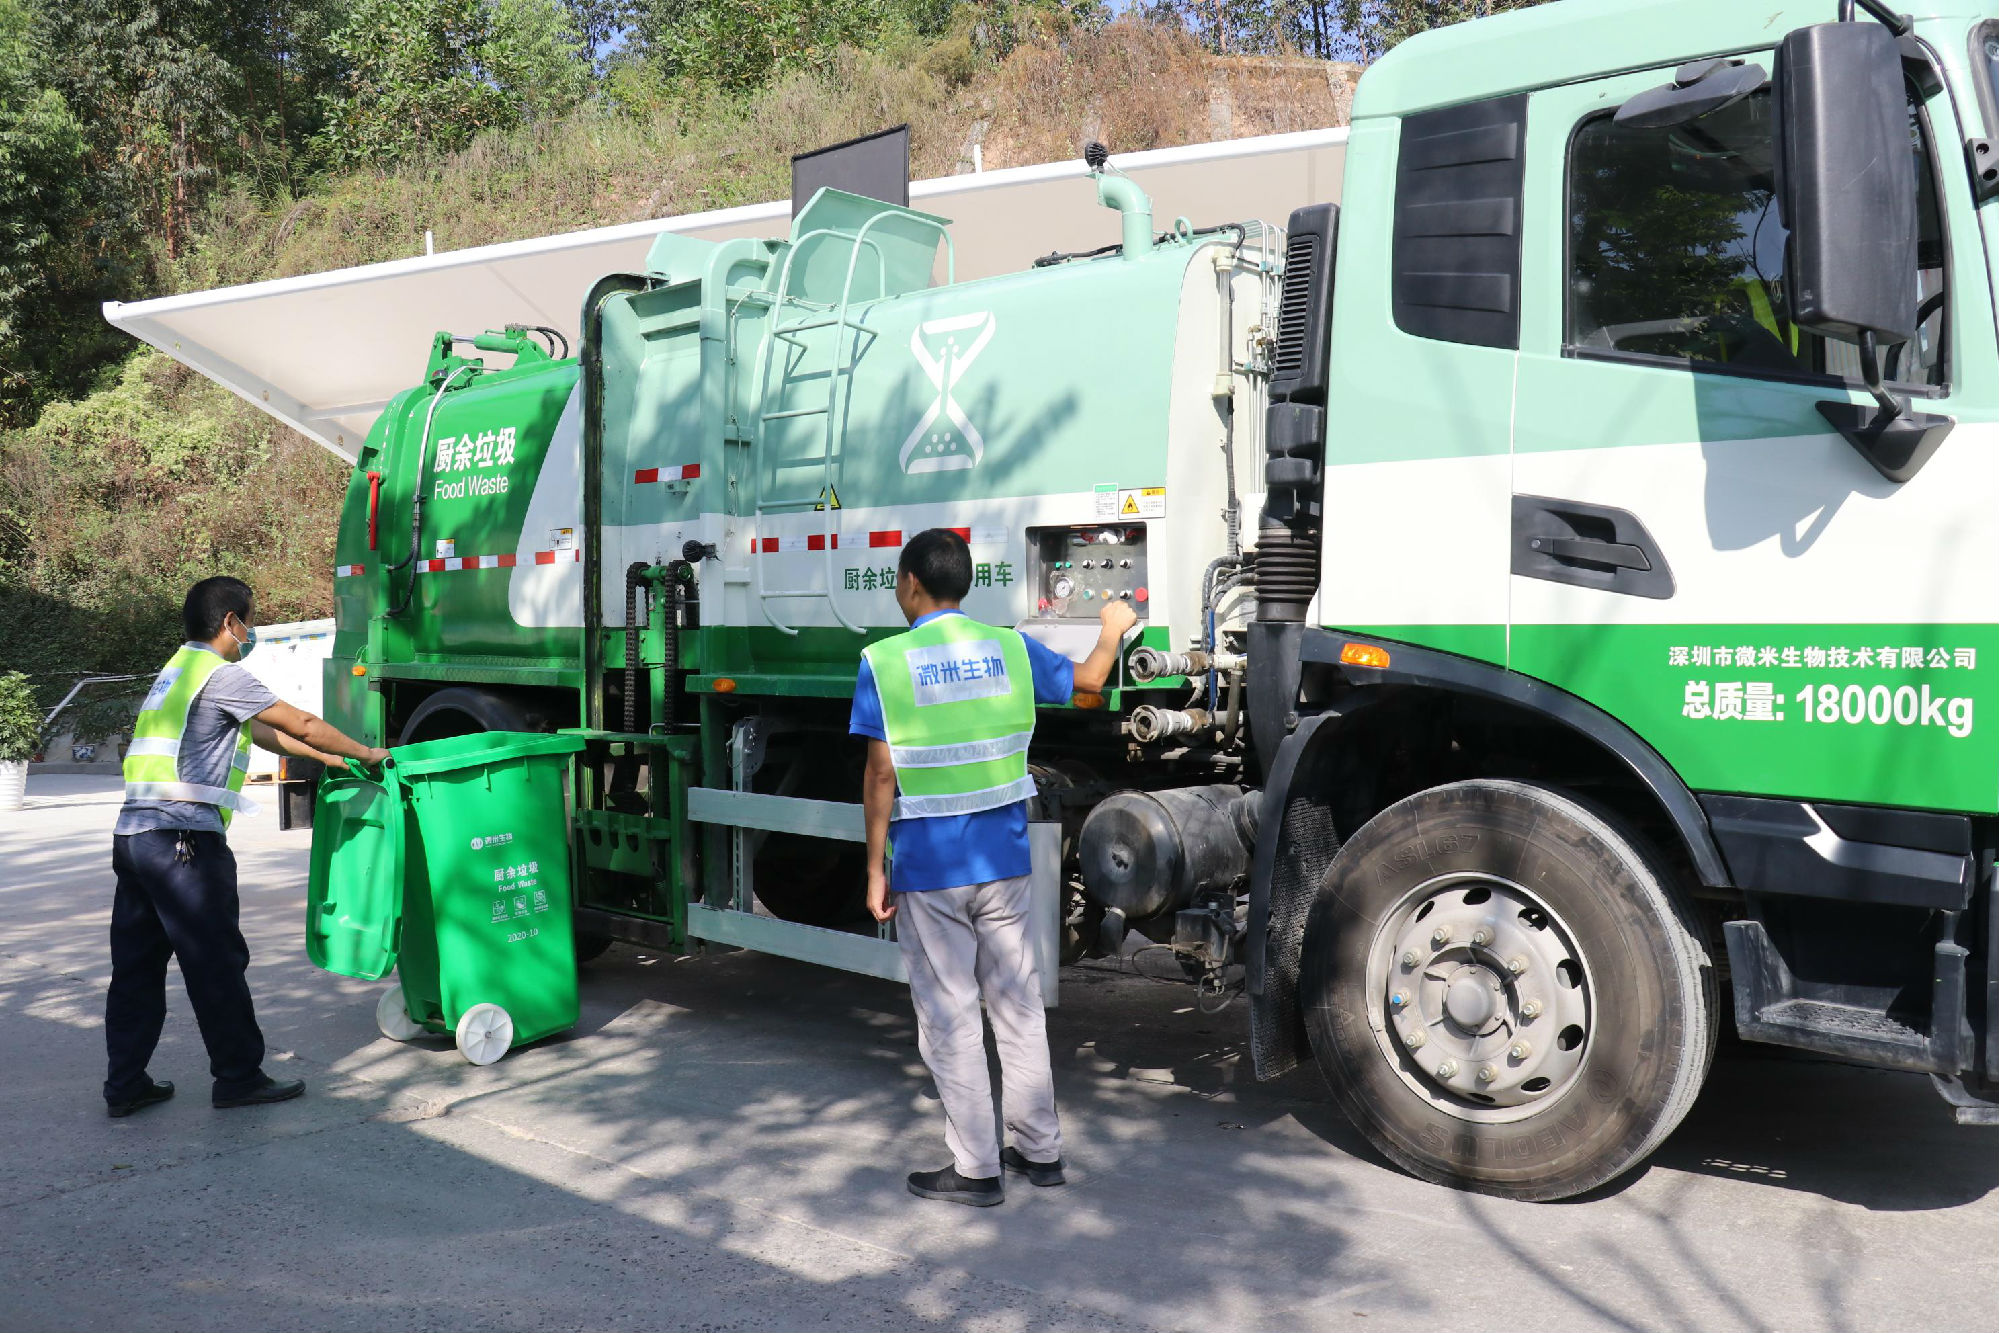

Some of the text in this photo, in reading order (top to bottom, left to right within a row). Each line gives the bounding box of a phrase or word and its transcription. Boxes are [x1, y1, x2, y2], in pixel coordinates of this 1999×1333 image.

[434, 427, 516, 473] 厨余垃圾
[434, 473, 509, 500] Food Waste
[1668, 645, 1977, 670] 深圳市微米生物技术有限公司
[915, 656, 1005, 687] 微米生物
[1796, 684, 1974, 738] 18000kg
[494, 861, 539, 882] 厨余垃圾
[498, 878, 537, 893] Food Waste
[507, 927, 539, 943] 2020-10
[1419, 1102, 1593, 1161] AEOLUS
